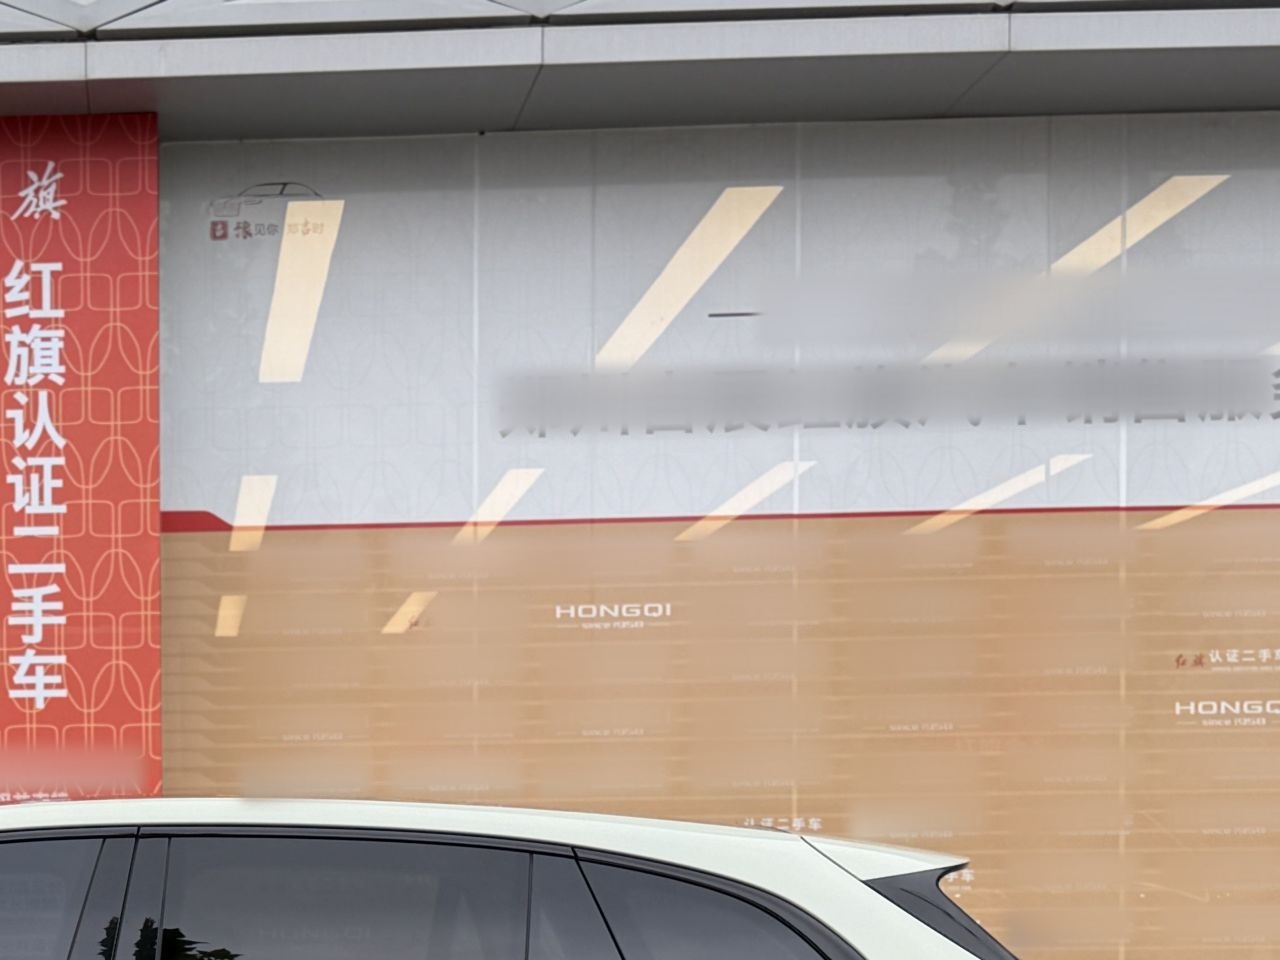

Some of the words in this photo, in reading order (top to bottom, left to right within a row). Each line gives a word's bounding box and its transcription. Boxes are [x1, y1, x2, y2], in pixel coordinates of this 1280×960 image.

[4, 260, 68, 710] 红旗认证二手车
[556, 602, 672, 619] HONGQI
